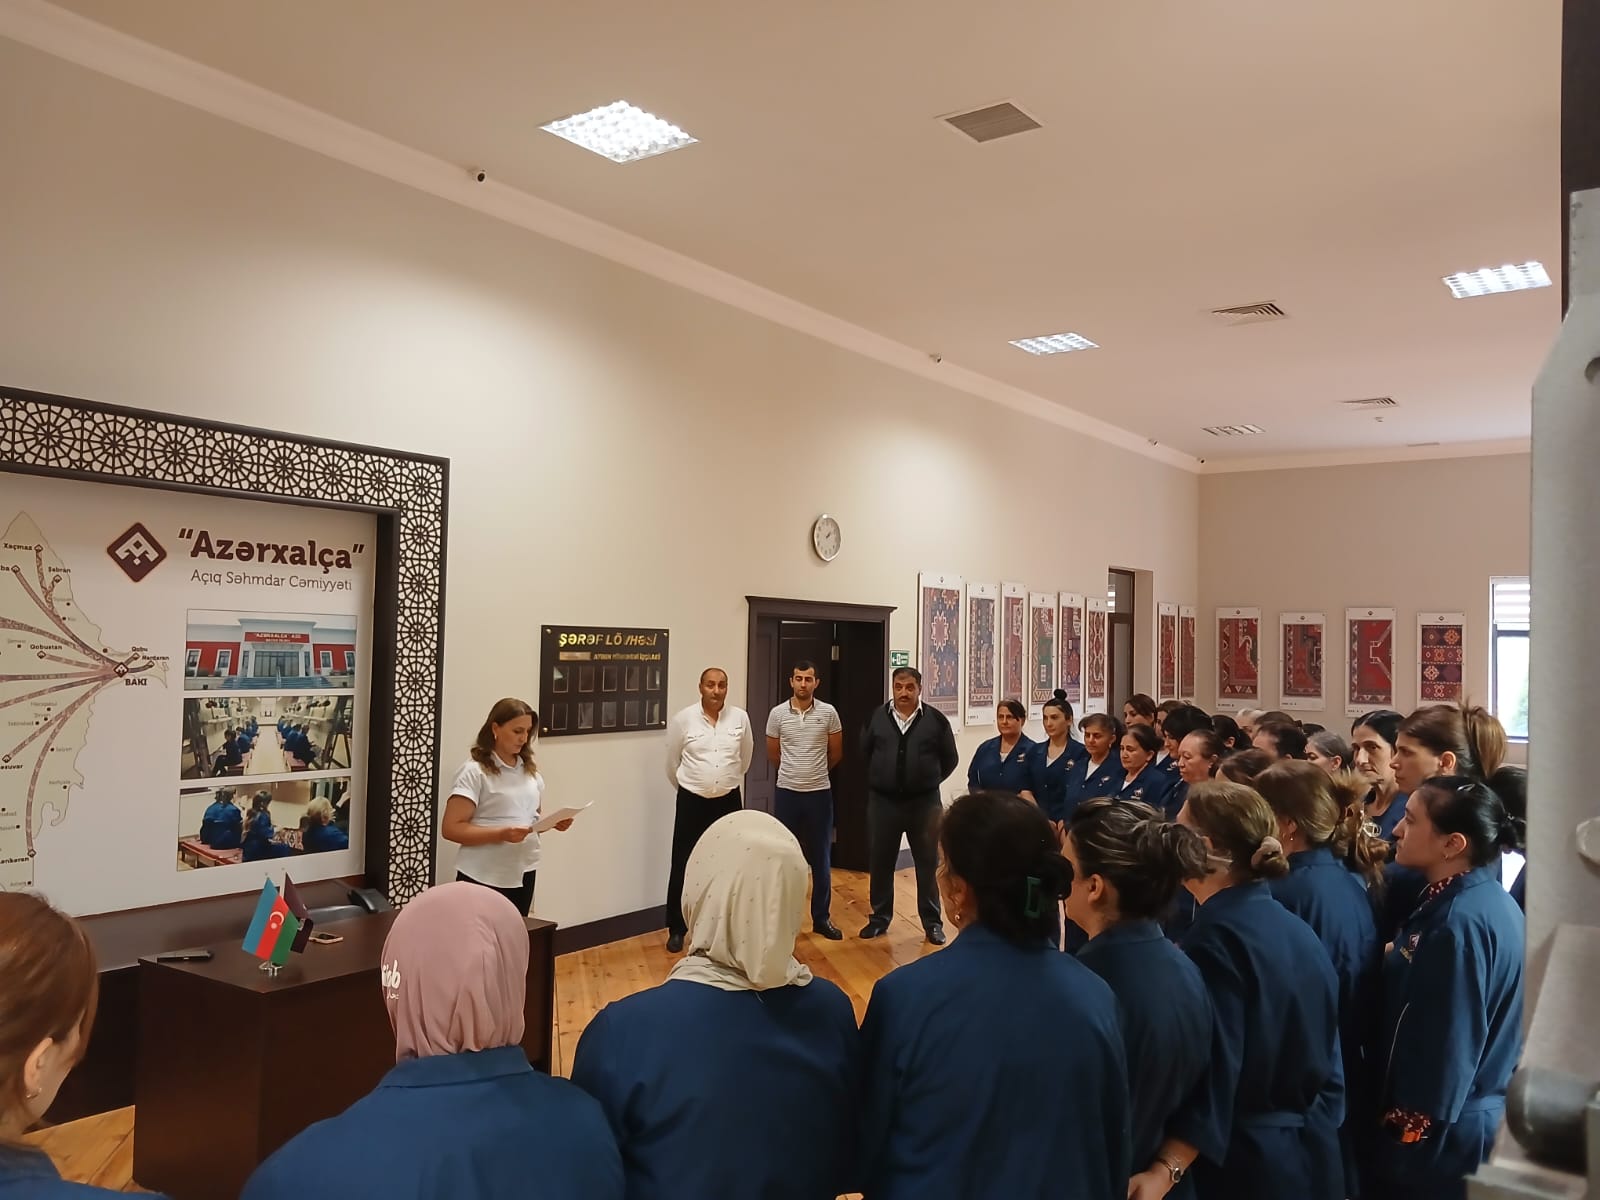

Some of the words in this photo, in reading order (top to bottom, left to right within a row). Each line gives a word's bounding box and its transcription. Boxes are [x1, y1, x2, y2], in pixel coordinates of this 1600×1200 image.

[190, 569, 222, 586] Açıq
[226, 571, 286, 587] Səhmdar
[289, 575, 352, 592] Cəmiyyəti
[559, 633, 604, 647] ŞƏRƏF
